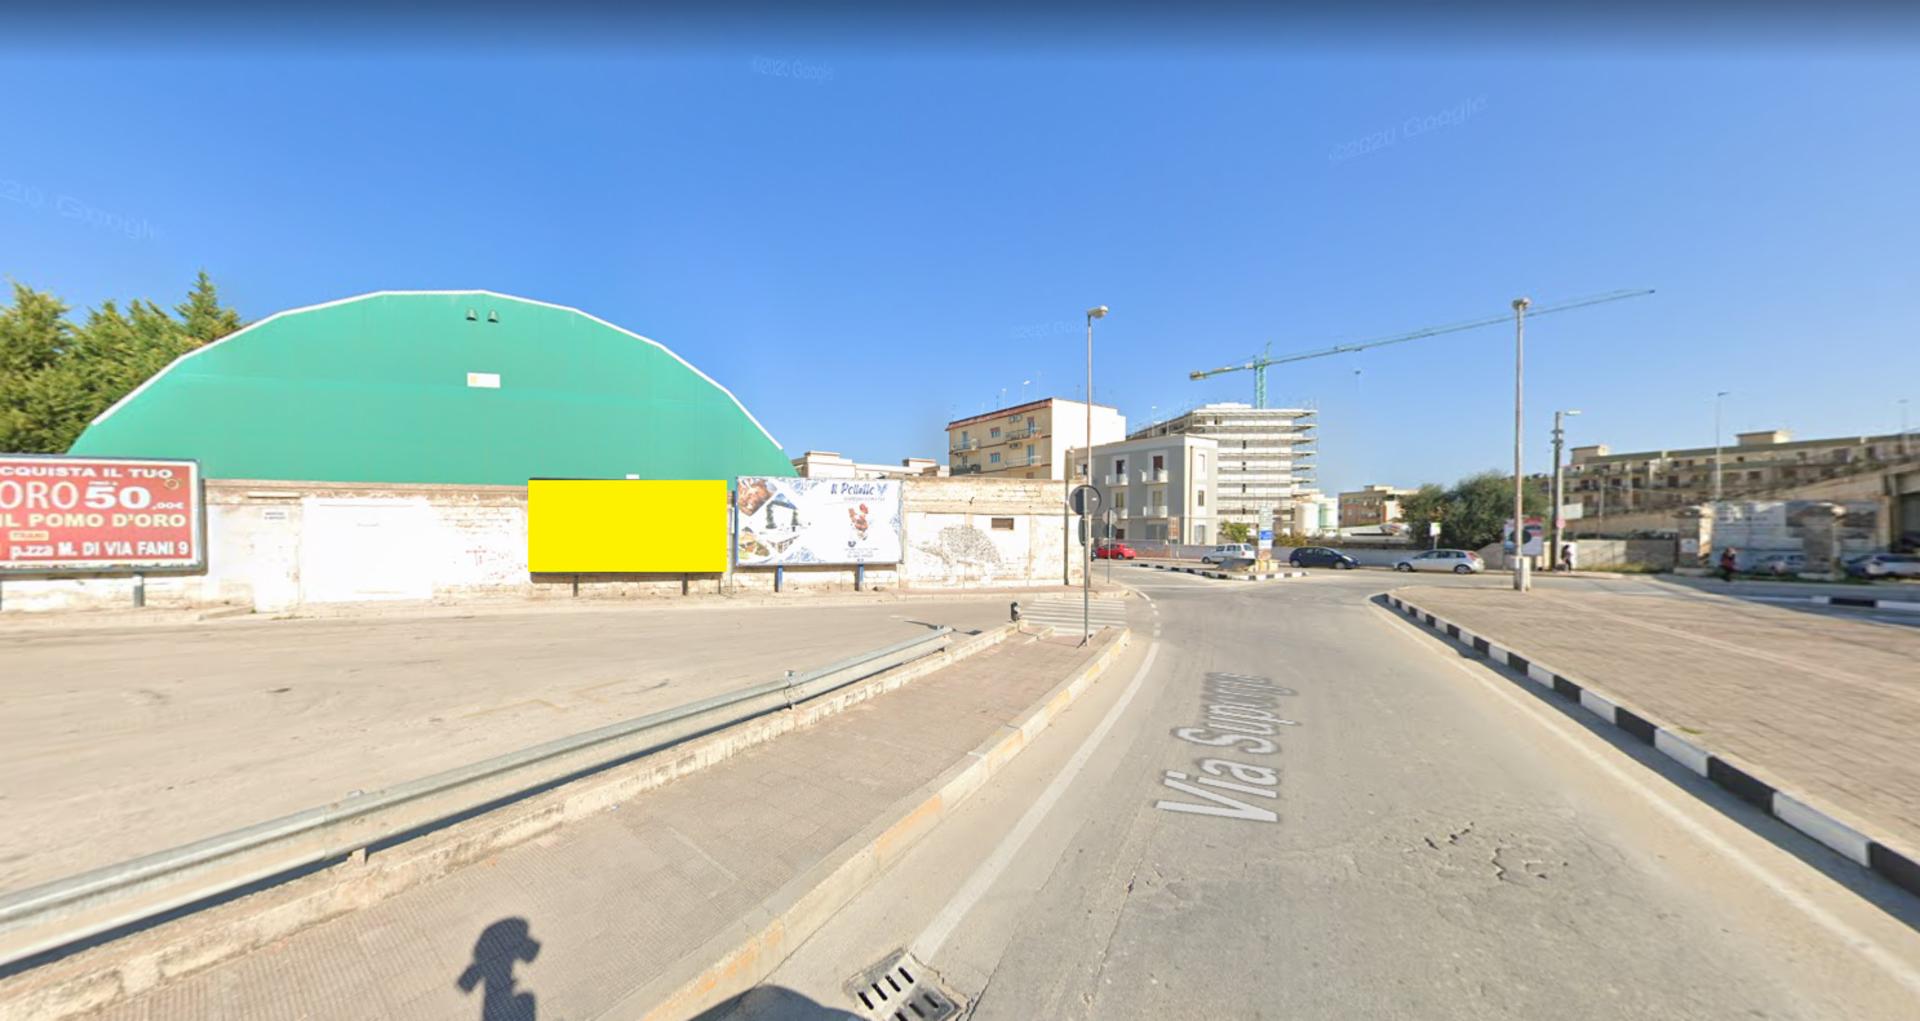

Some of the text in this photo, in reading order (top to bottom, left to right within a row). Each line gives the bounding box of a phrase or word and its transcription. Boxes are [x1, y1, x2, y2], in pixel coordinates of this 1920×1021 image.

[103, 468, 122, 477] IL
[128, 468, 173, 479] TUO
[0, 480, 79, 509] ORO
[0, 513, 187, 528] IL POMO D'ORO
[82, 541, 100, 556] DI
[104, 541, 134, 556] VIA
[137, 541, 174, 555] FANI
[178, 541, 189, 555] 9
